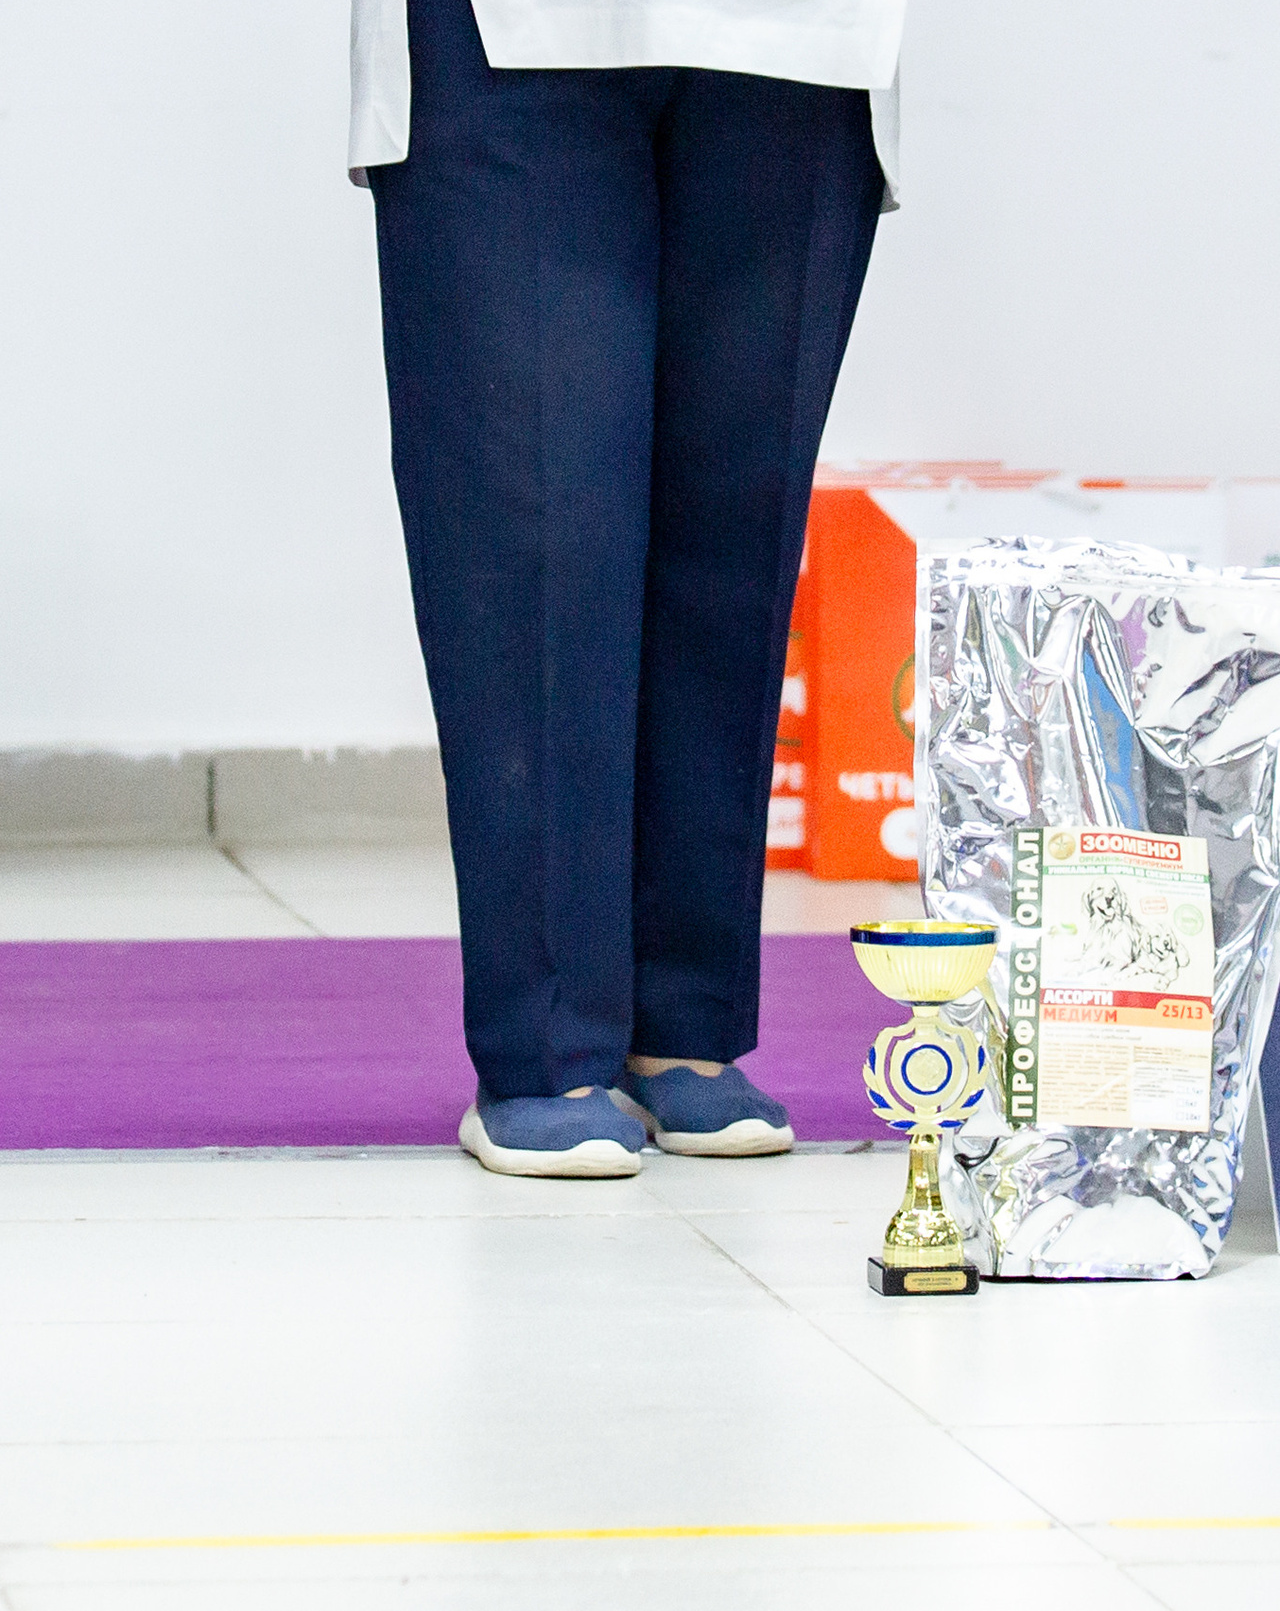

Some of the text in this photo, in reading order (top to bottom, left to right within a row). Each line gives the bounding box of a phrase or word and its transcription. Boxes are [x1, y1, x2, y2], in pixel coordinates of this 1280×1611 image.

[1082, 834, 1179, 860] ЗООМЕНЮ
[1043, 989, 1114, 1006] АССОРТИ
[1043, 1007, 1118, 1023] МЕДИУМ
[1162, 1003, 1203, 1020] 25/13
